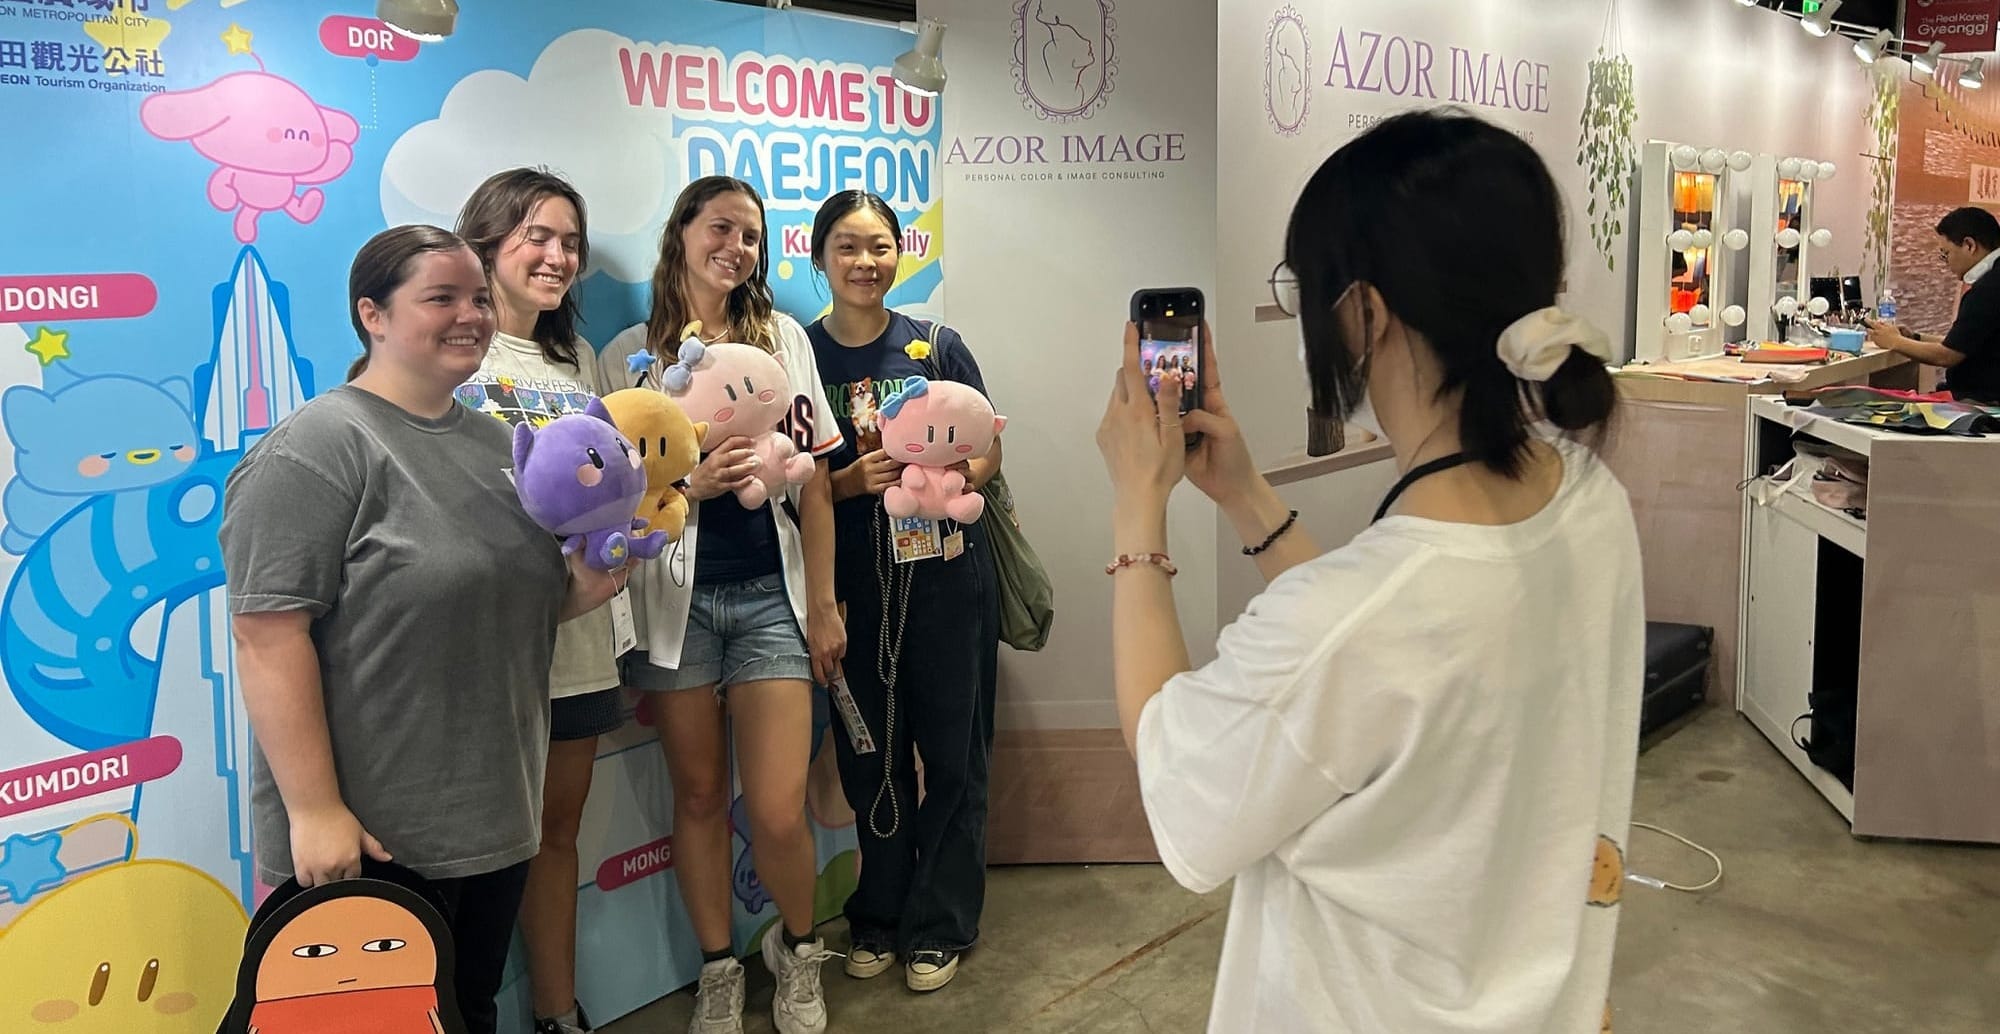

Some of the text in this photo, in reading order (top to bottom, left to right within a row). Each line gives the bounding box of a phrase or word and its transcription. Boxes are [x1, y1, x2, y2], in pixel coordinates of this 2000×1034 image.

[23, 8, 118, 25] METROPOLITAN
[124, 17, 149, 28] CITY
[347, 26, 394, 51] DOR
[34, 76, 85, 89] Tourism
[88, 79, 166, 93] Organization
[1324, 26, 1551, 113] AZOR IMAGE
[618, 47, 930, 127] WELCOME TO
[945, 133, 1186, 164] AZOR IMAGE
[687, 137, 930, 202] DAEJEON
[965, 173, 1017, 182] PERSONAL
[1020, 173, 1053, 181] COLOR
[1066, 172, 1098, 180] IMAGE
[1101, 171, 1165, 180] CONSULTING
[0, 285, 98, 311] DONGI
[0, 754, 129, 804] KUMDORI
[623, 844, 671, 877] MONG
